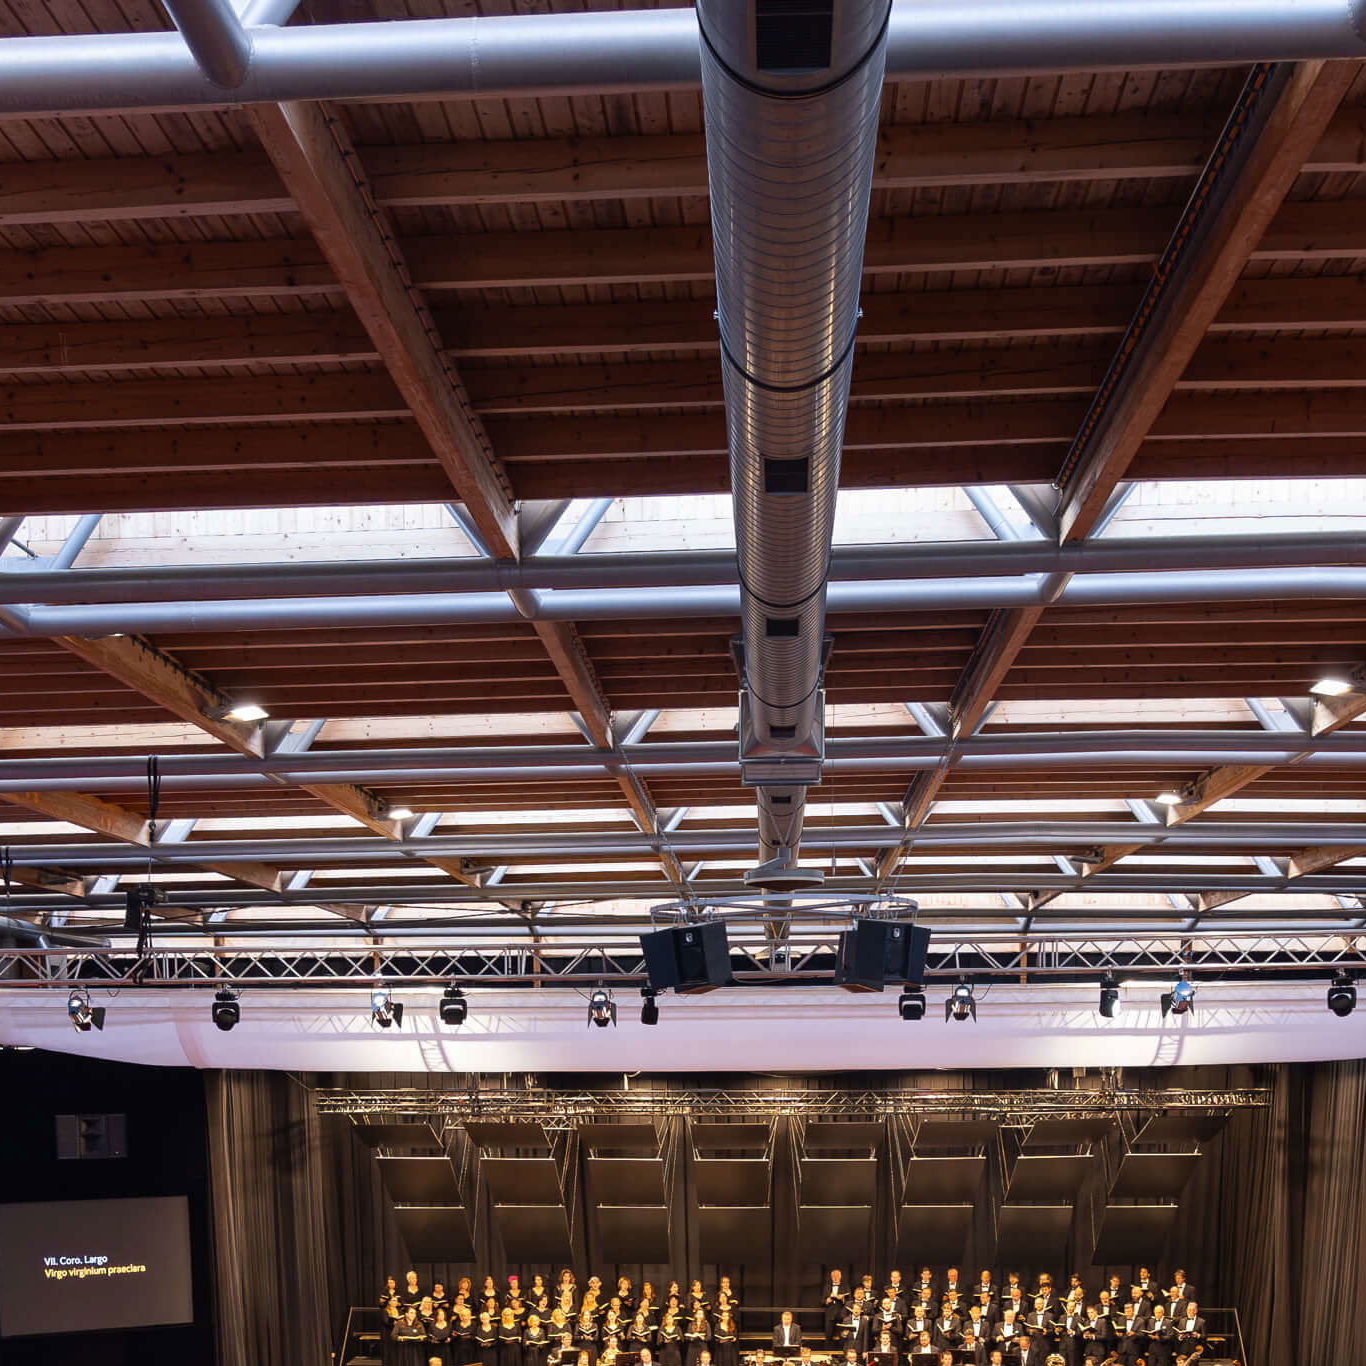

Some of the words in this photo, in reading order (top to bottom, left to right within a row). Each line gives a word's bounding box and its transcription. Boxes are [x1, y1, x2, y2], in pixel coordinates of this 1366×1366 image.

[44, 1257, 58, 1266] VII.
[59, 1257, 83, 1265] Coro.
[84, 1255, 108, 1265] Largo
[45, 1268, 68, 1280] Virgo
[68, 1267, 107, 1278] virginium
[108, 1264, 146, 1276] praeclara
